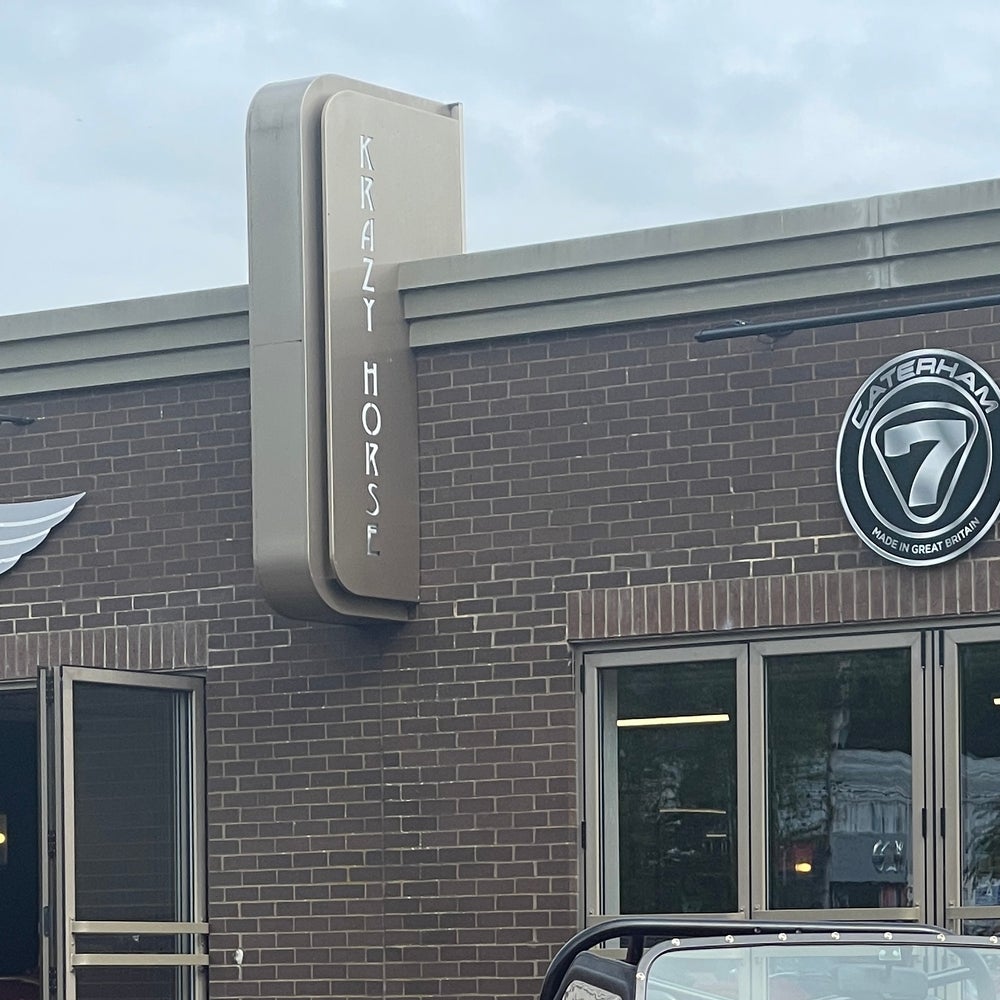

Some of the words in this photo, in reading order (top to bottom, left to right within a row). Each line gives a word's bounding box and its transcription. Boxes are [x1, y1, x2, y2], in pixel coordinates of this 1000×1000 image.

[359, 134, 375, 332] KRAZY
[851, 357, 999, 430] CATERHAM
[362, 361, 381, 556] HORSE
[884, 419, 966, 507] 7
[871, 526, 899, 549] MADE
[899, 541, 910, 552] IN
[911, 541, 943, 554] GREAT
[945, 517, 981, 548] BRITAIN
